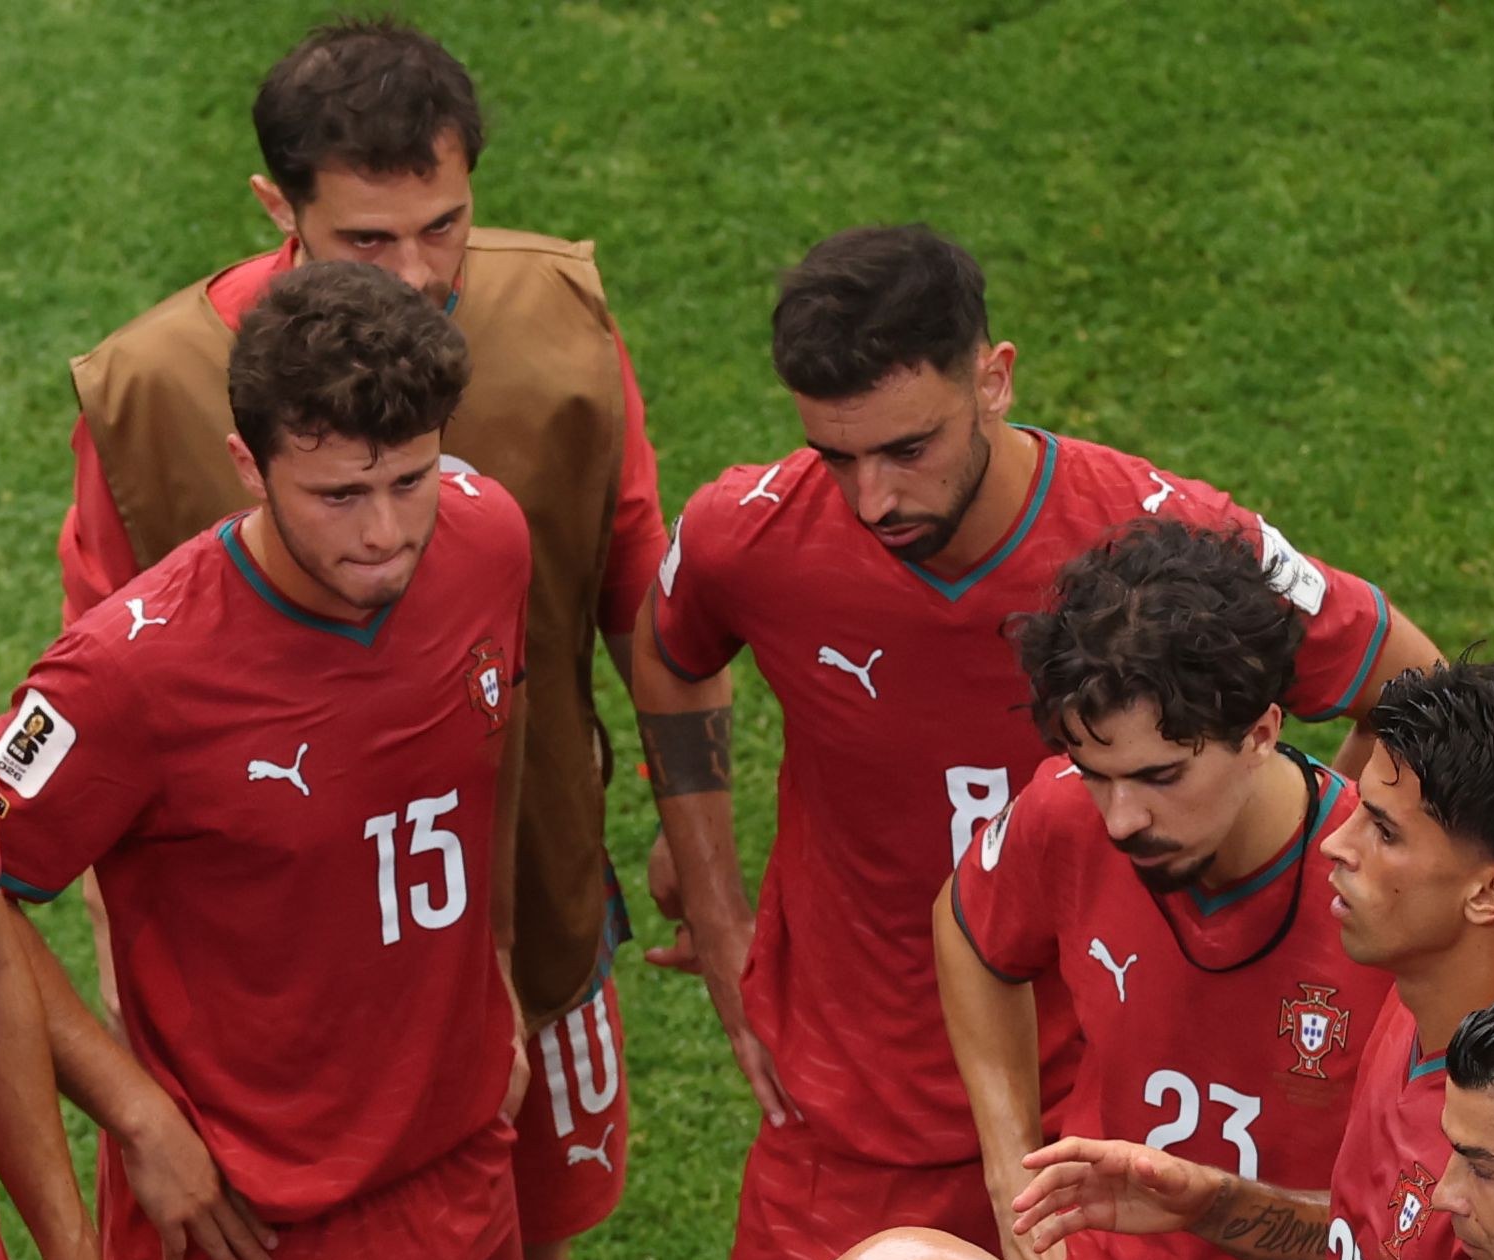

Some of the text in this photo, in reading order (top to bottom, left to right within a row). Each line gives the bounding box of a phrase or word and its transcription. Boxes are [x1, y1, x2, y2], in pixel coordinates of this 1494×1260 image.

[363, 788, 468, 946] 15
[539, 988, 619, 1138] 10
[1143, 1069, 1261, 1182] 23
